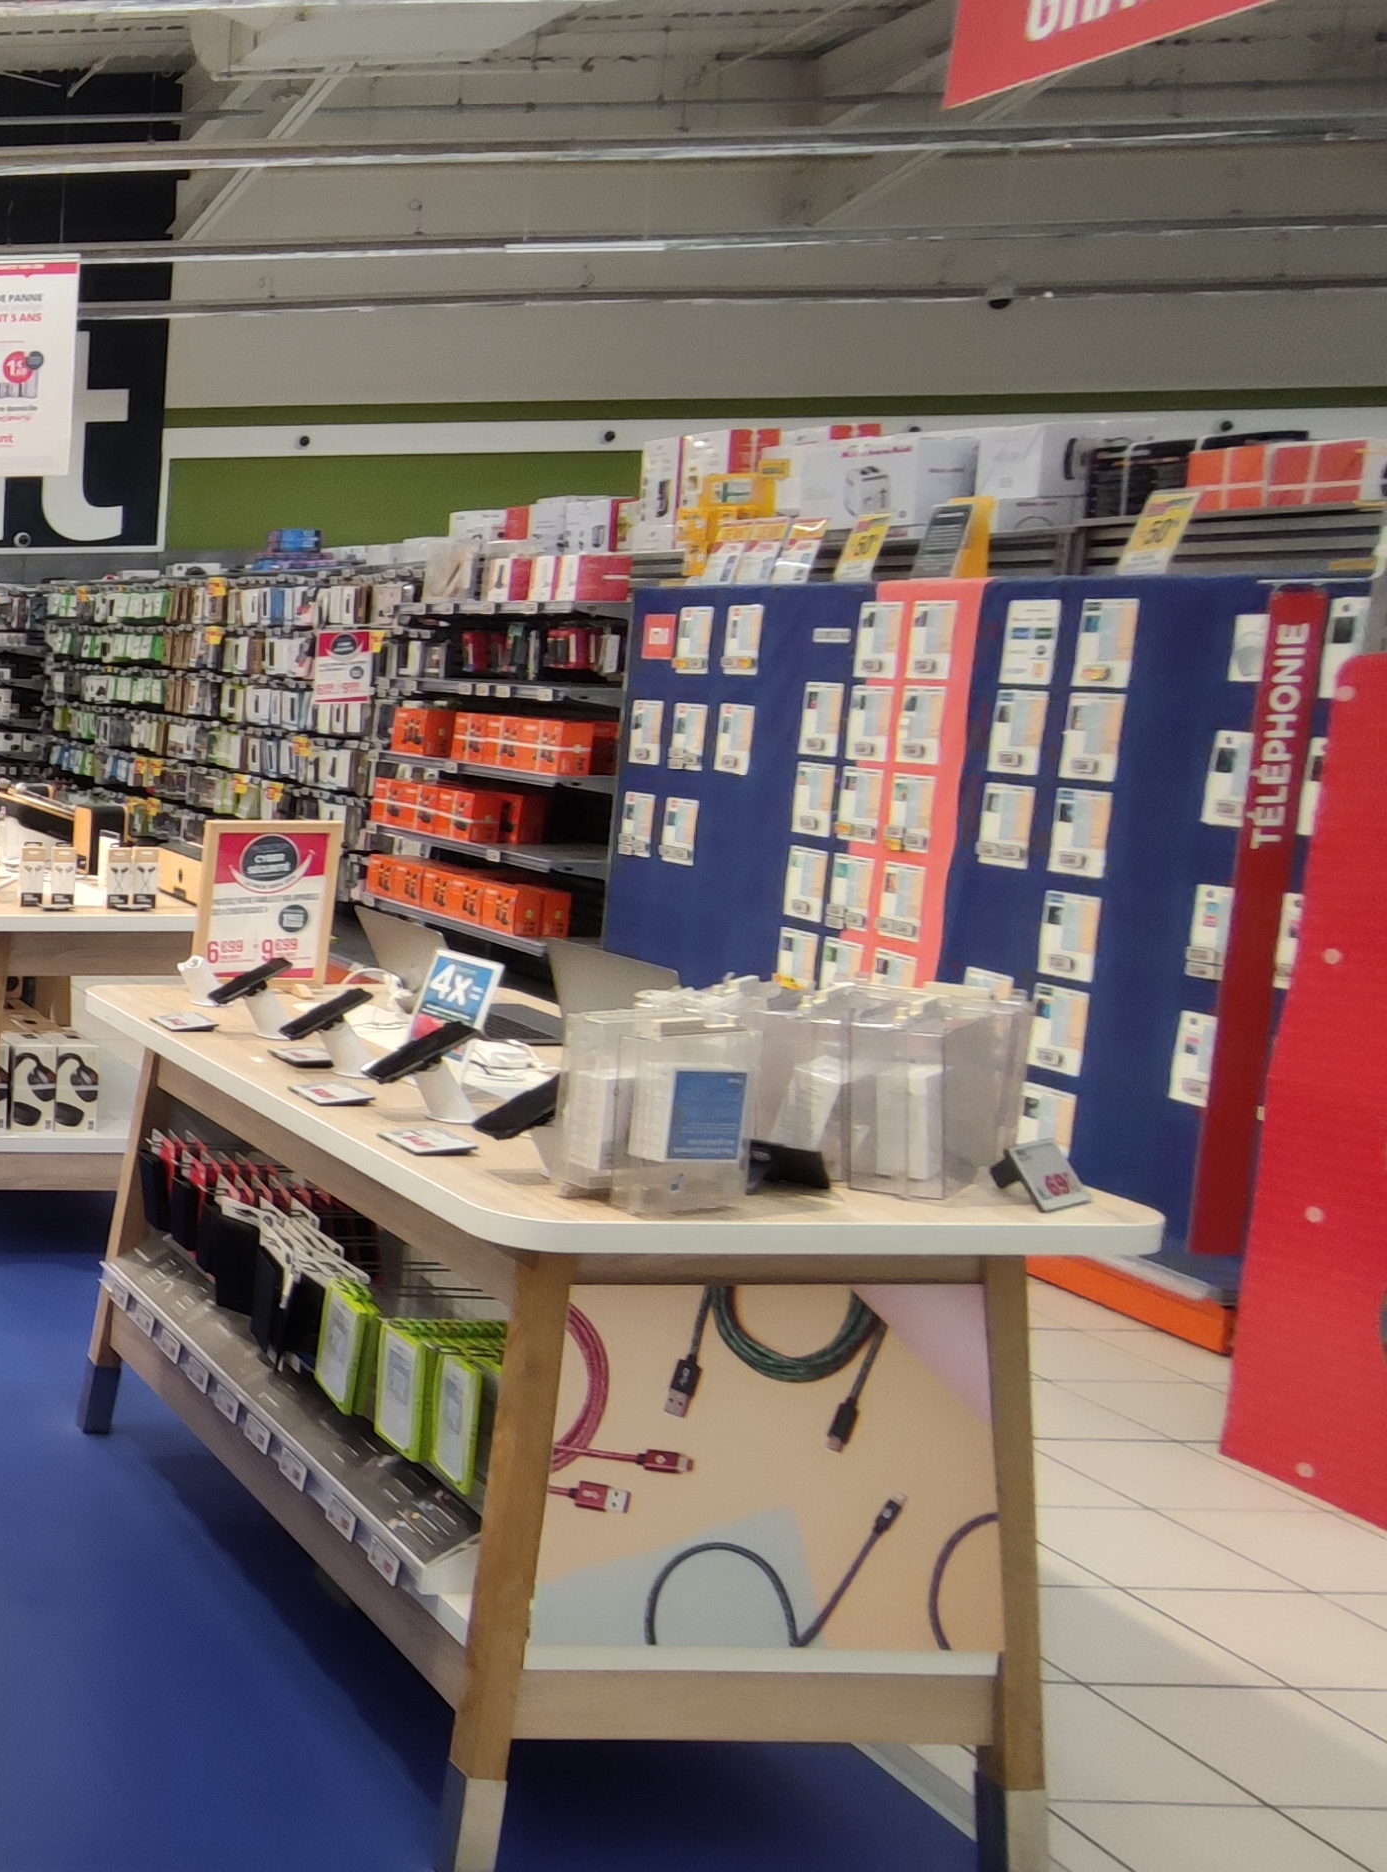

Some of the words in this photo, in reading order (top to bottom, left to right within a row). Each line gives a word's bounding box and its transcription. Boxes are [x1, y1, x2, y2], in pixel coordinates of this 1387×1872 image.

[8, 293, 44, 302] PANNE
[19, 313, 42, 322] ANS
[1249, 620, 1311, 851] TÉLÉPHONIE
